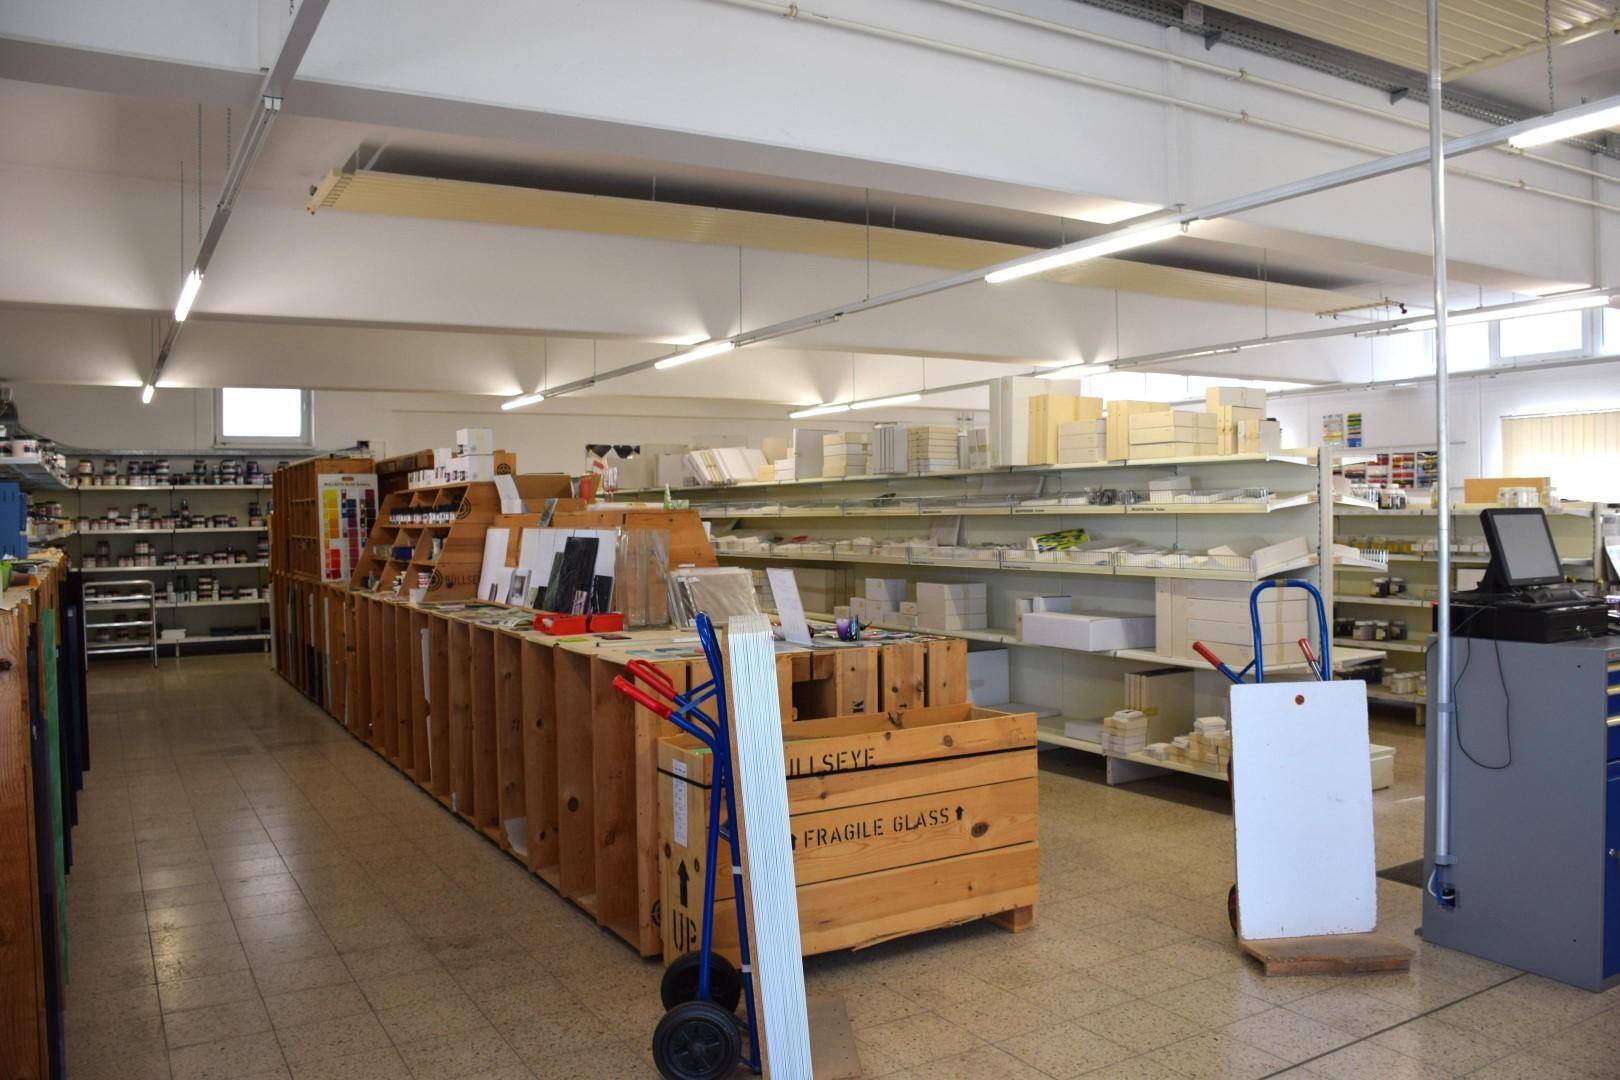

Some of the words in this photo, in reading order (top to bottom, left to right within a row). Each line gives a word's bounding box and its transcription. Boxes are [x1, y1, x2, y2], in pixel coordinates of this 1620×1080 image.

[804, 818, 884, 848] FRAGILE
[893, 807, 949, 833] GLASS
[672, 908, 697, 953] UP
